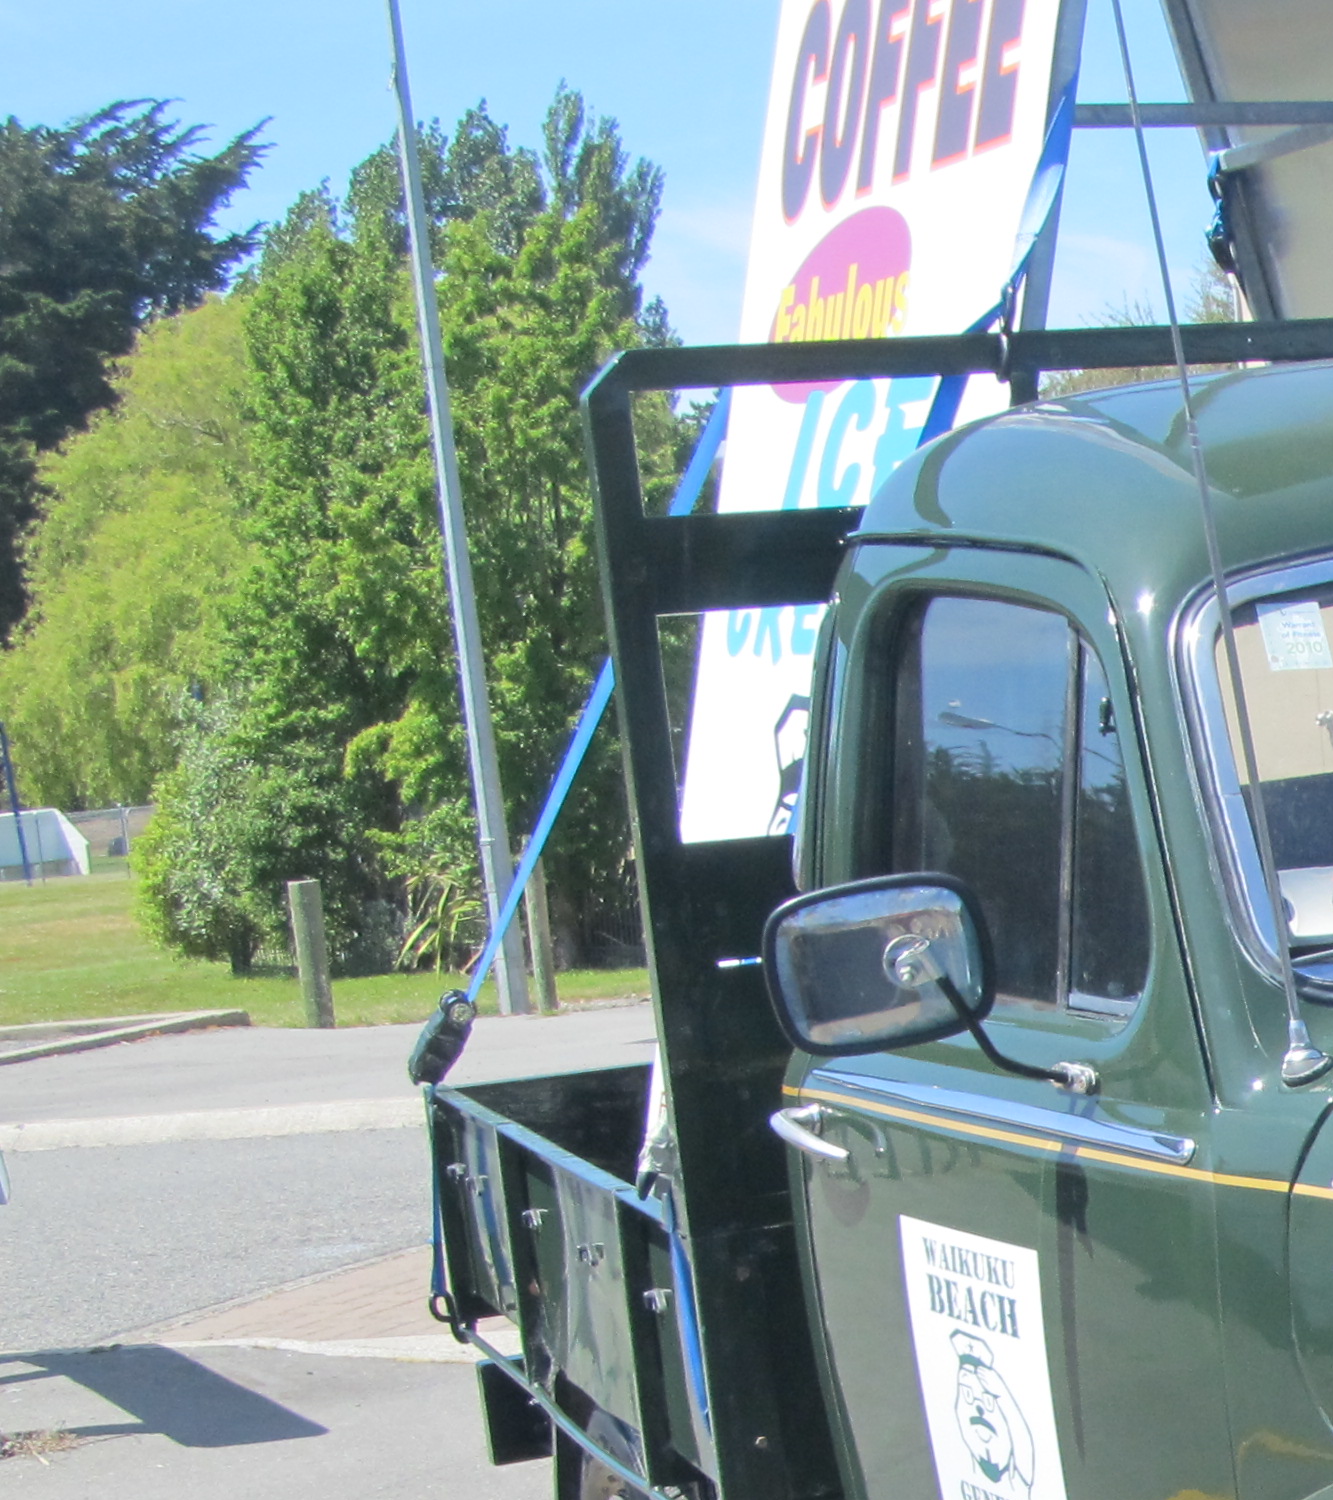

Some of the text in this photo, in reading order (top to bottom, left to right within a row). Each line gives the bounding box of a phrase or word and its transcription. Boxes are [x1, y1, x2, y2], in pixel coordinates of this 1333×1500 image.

[781, 0, 1026, 227] COFFEE
[774, 262, 910, 342] Fabulous
[782, 377, 937, 510] ICE
[921, 1236, 1015, 1289] WAIKUKU
[926, 1272, 1020, 1339] BEACH
